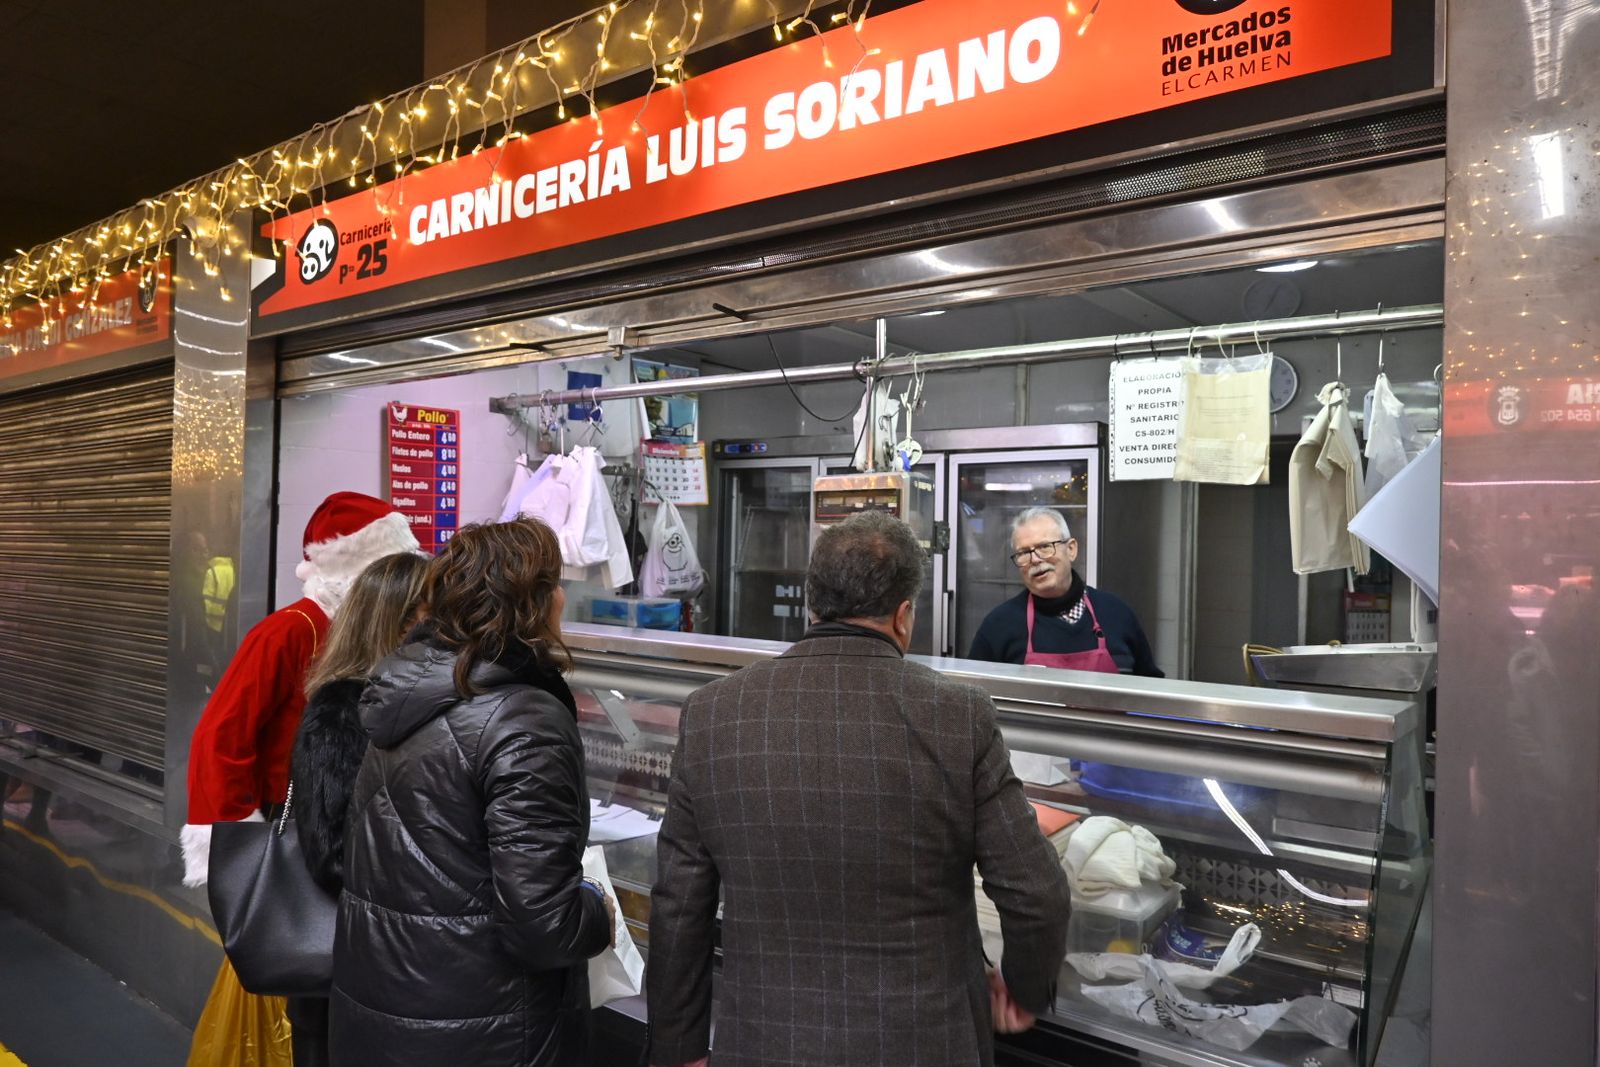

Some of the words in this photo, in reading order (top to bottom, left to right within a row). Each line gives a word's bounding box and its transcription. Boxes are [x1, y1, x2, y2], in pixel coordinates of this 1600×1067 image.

[1162, 6, 1292, 55] Mercados
[1161, 56, 1192, 76] de
[1198, 30, 1291, 67] Huelva
[409, 139, 631, 246] CARNICERÍA
[645, 106, 747, 184] LUIS
[763, 15, 1061, 151] SORIANO
[340, 217, 392, 246] Carnicería
[1138, 387, 1172, 395] PROPIA
[417, 409, 447, 423] Pollo
[392, 429, 407, 439] Pollo
[408, 430, 430, 441] Entero
[410, 447, 418, 456] de
[418, 448, 434, 459] pollo
[1119, 444, 1149, 452] VENTA
[404, 480, 412, 489] de
[412, 481, 429, 491] pollo
